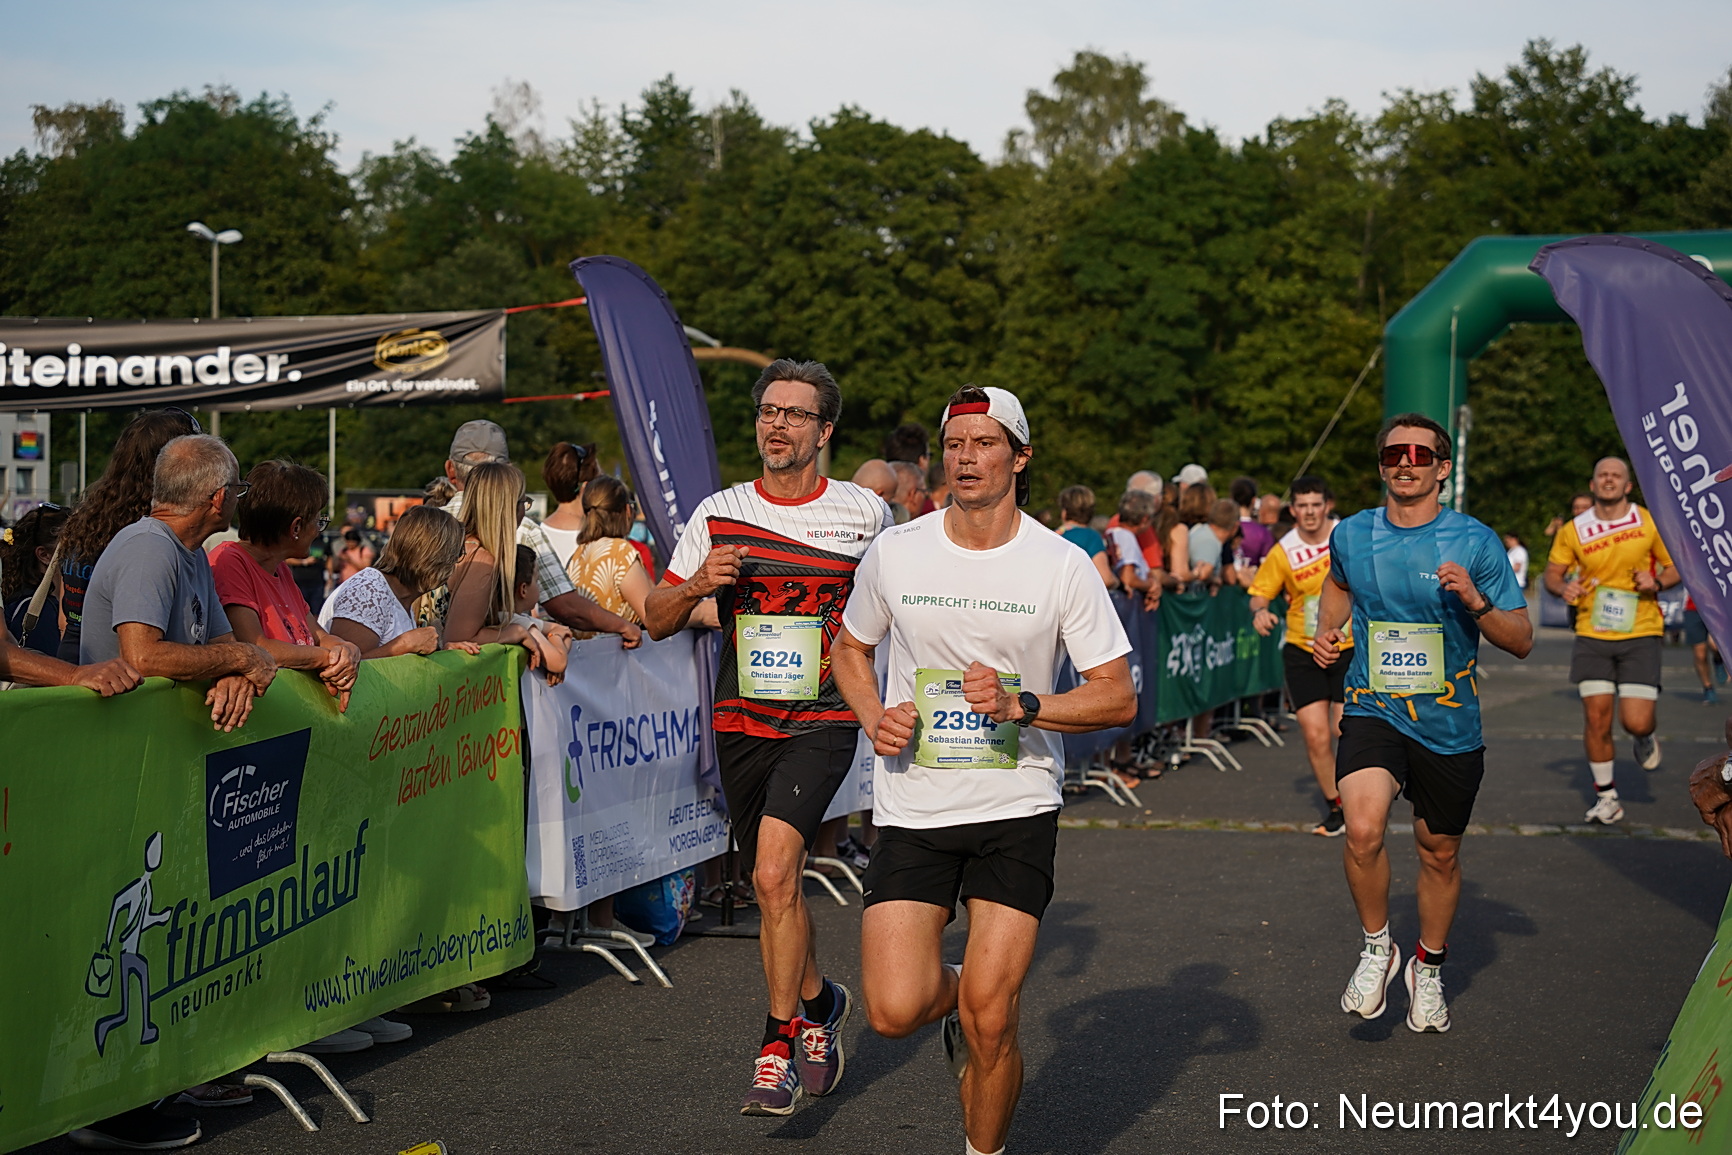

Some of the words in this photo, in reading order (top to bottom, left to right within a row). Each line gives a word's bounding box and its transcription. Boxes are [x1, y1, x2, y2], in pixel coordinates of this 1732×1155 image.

[346, 380, 366, 392] Ein
[415, 376, 480, 392] verbindet.
[807, 530, 856, 540] NEUMARKT
[903, 525, 921, 534] JAKO
[1583, 540, 1610, 556] MAX
[901, 594, 969, 609] RUPPRECHT
[979, 599, 1036, 615] HOLZBAU
[750, 650, 802, 668] 2624
[1381, 652, 1427, 667] 2826
[751, 670, 783, 680] Christian
[784, 671, 804, 681] Jäger
[369, 684, 450, 761] Gesunde
[453, 675, 506, 723] Firmen
[933, 710, 998, 731] 2394
[928, 735, 972, 745] Sebastian
[974, 736, 1005, 746] Renner
[397, 744, 452, 806] laufen
[457, 726, 521, 781] länger
[223, 780, 289, 818] Fischer
[228, 803, 281, 832] AUTOMOBILE
[668, 803, 694, 826] HEUTE
[669, 829, 701, 854] MORGEN
[167, 817, 369, 986] firmenlauf
[304, 903, 529, 1012] www.firmenlauf-oberpfalz.de
[171, 954, 263, 1026] neumarkt
